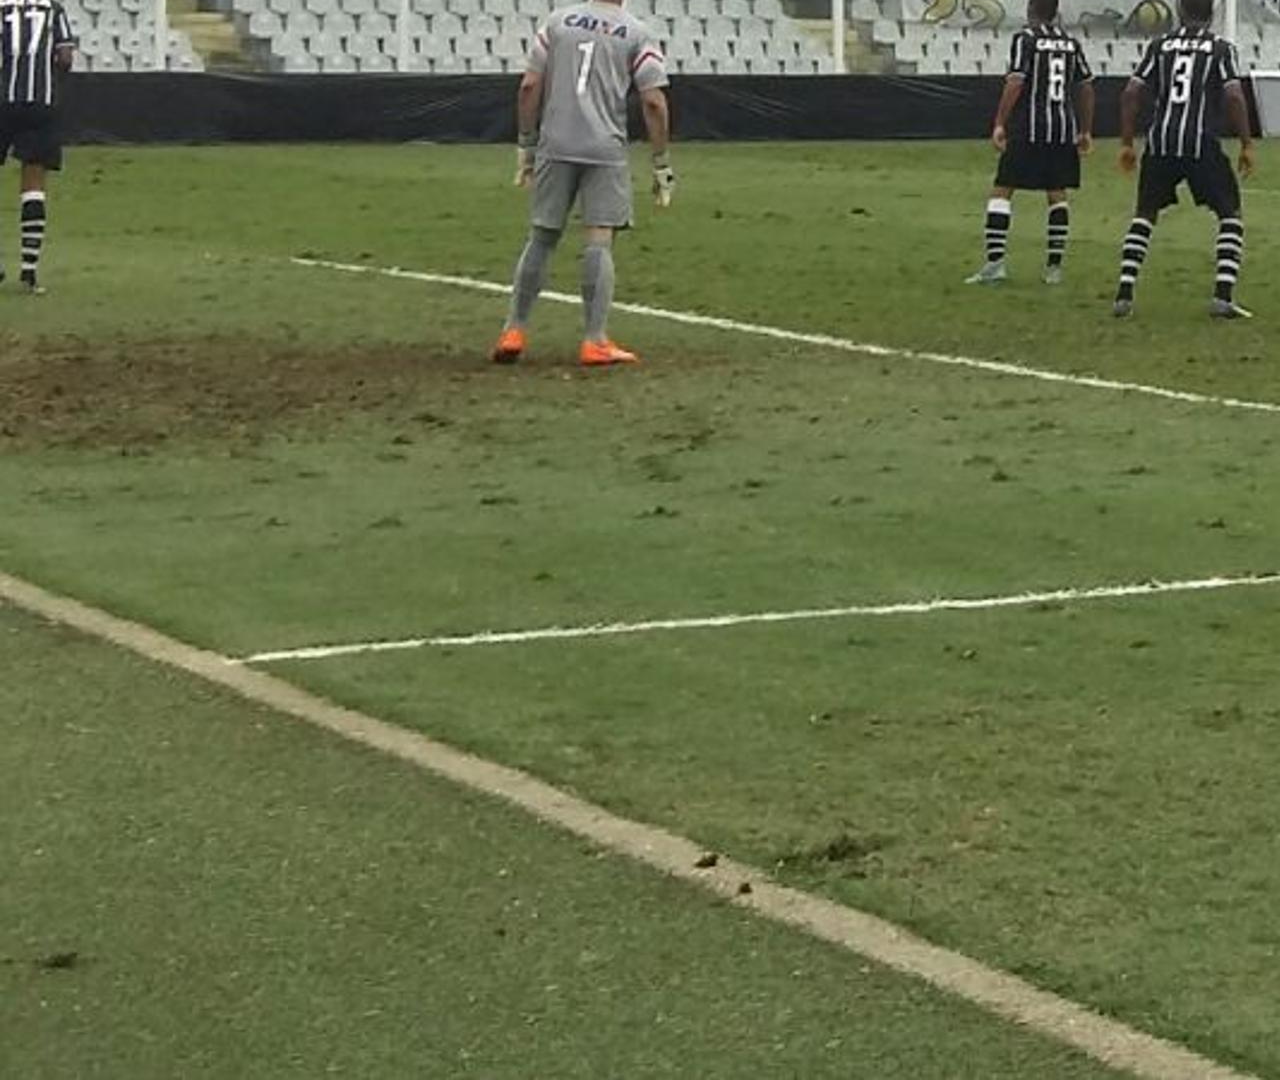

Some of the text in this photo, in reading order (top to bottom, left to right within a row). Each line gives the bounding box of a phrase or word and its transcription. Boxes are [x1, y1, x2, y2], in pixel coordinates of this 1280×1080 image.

[4, 8, 46, 55] 17
[563, 13, 628, 39] CAIXA
[576, 41, 596, 96] 1
[1049, 56, 1066, 102] 6
[1170, 55, 1194, 104] 3
